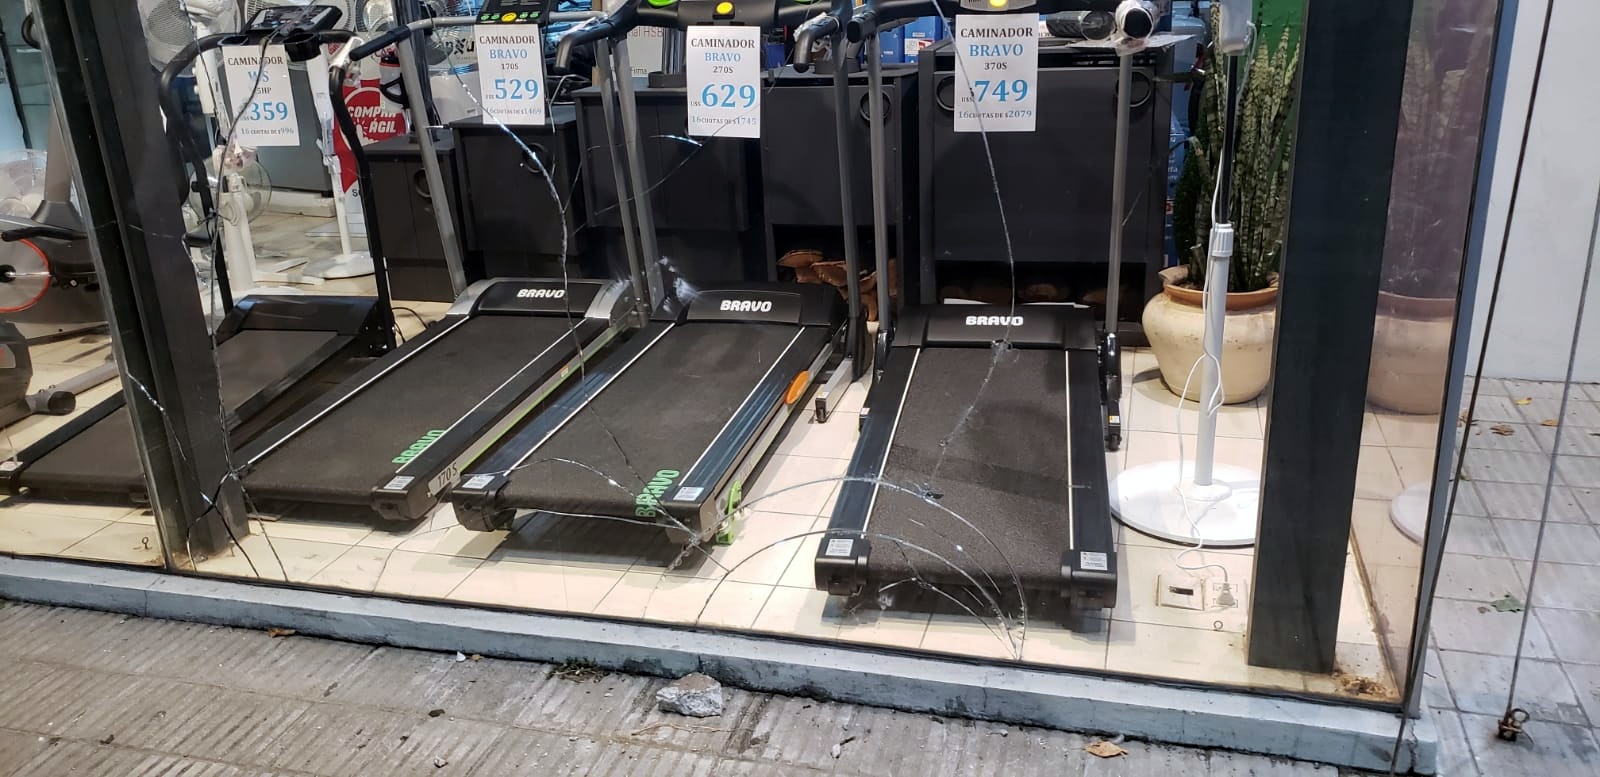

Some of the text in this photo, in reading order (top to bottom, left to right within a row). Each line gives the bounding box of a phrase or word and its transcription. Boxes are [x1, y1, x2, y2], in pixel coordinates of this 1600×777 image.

[960, 28, 1033, 38] CAMINADOR
[480, 35, 536, 44] CAMINADOR
[691, 38, 755, 48] CAMINADOR
[489, 49, 528, 59] BRAVO
[969, 44, 1024, 57] BRAVO
[705, 52, 741, 62] BRAVO
[712, 65, 734, 74] 270S
[984, 62, 1008, 71] 370S
[368, 118, 397, 133] ÁGIL
[516, 288, 566, 299] BRAVO
[720, 299, 772, 312] BRAVO
[965, 315, 1024, 326] BRAVO
[391, 429, 447, 464] BRAVO
[634, 469, 680, 518] BRAVO
